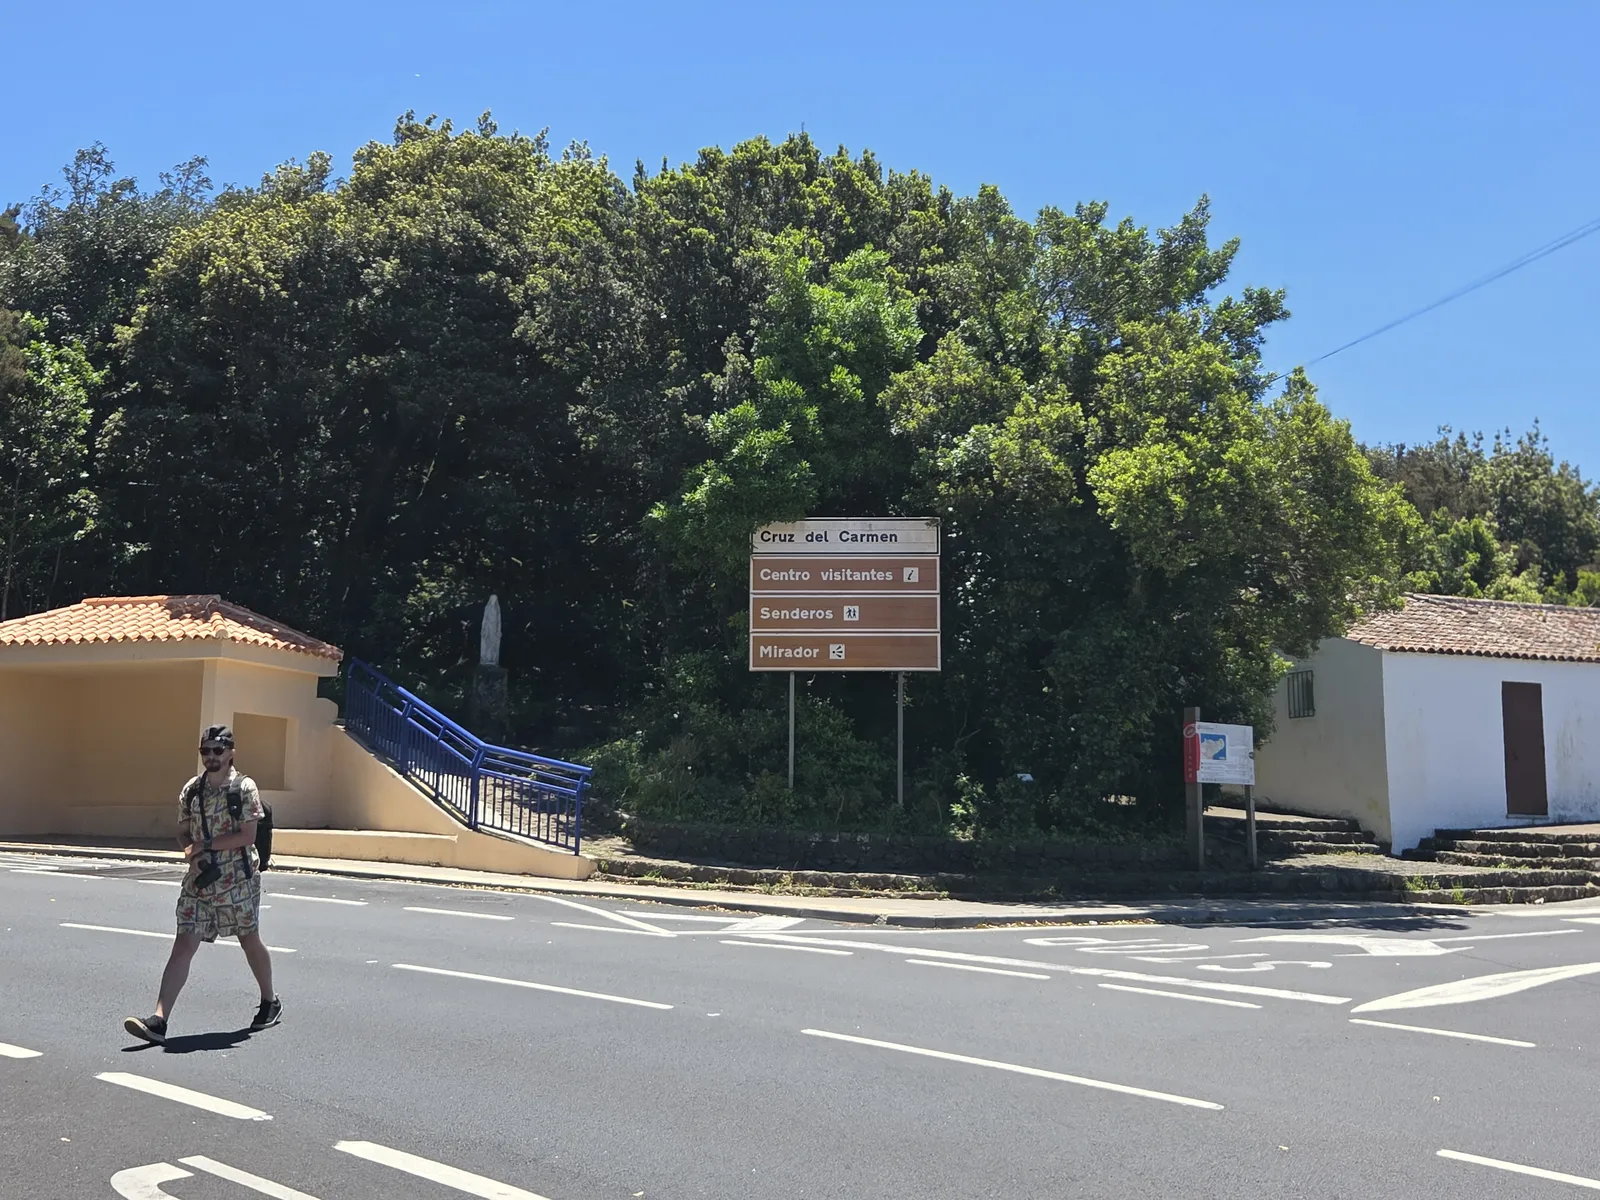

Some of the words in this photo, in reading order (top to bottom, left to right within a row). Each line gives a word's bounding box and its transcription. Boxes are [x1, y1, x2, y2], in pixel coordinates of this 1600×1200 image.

[760, 530, 795, 543] Cruz
[805, 531, 829, 543] del
[839, 530, 898, 543] Carmen
[760, 568, 810, 581] Centro
[821, 568, 893, 581] visitantes
[760, 607, 833, 620] Senderos
[759, 645, 819, 658] Mirador
